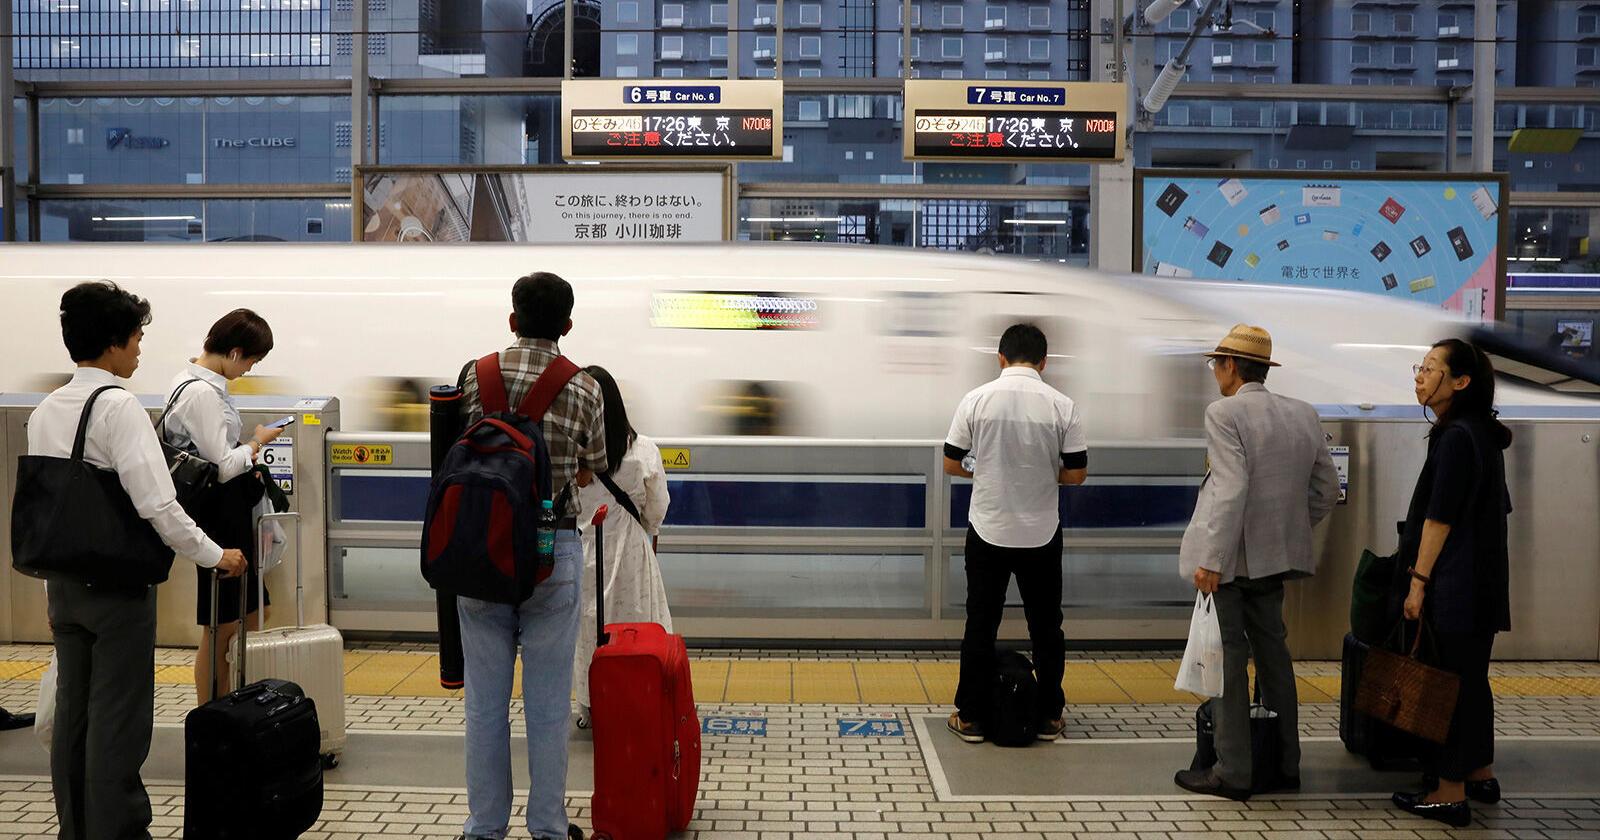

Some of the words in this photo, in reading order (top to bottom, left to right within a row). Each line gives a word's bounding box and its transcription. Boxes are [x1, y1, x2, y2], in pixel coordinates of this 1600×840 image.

[675, 93, 690, 101] Car
[692, 93, 706, 101] No.
[709, 93, 715, 101] 6
[1020, 94, 1034, 102] Car
[1037, 94, 1050, 102] No.
[644, 116, 685, 131] 17:26
[987, 118, 1029, 132] 17:26
[212, 138, 243, 147] The
[248, 137, 295, 147] CUBE
[555, 195, 702, 207] この旅に、終わりはない。
[593, 212, 626, 220] journey,
[574, 223, 607, 239] 京都
[615, 223, 682, 239] 小川珈琲
[1281, 265, 1360, 279] 電池で世界を
